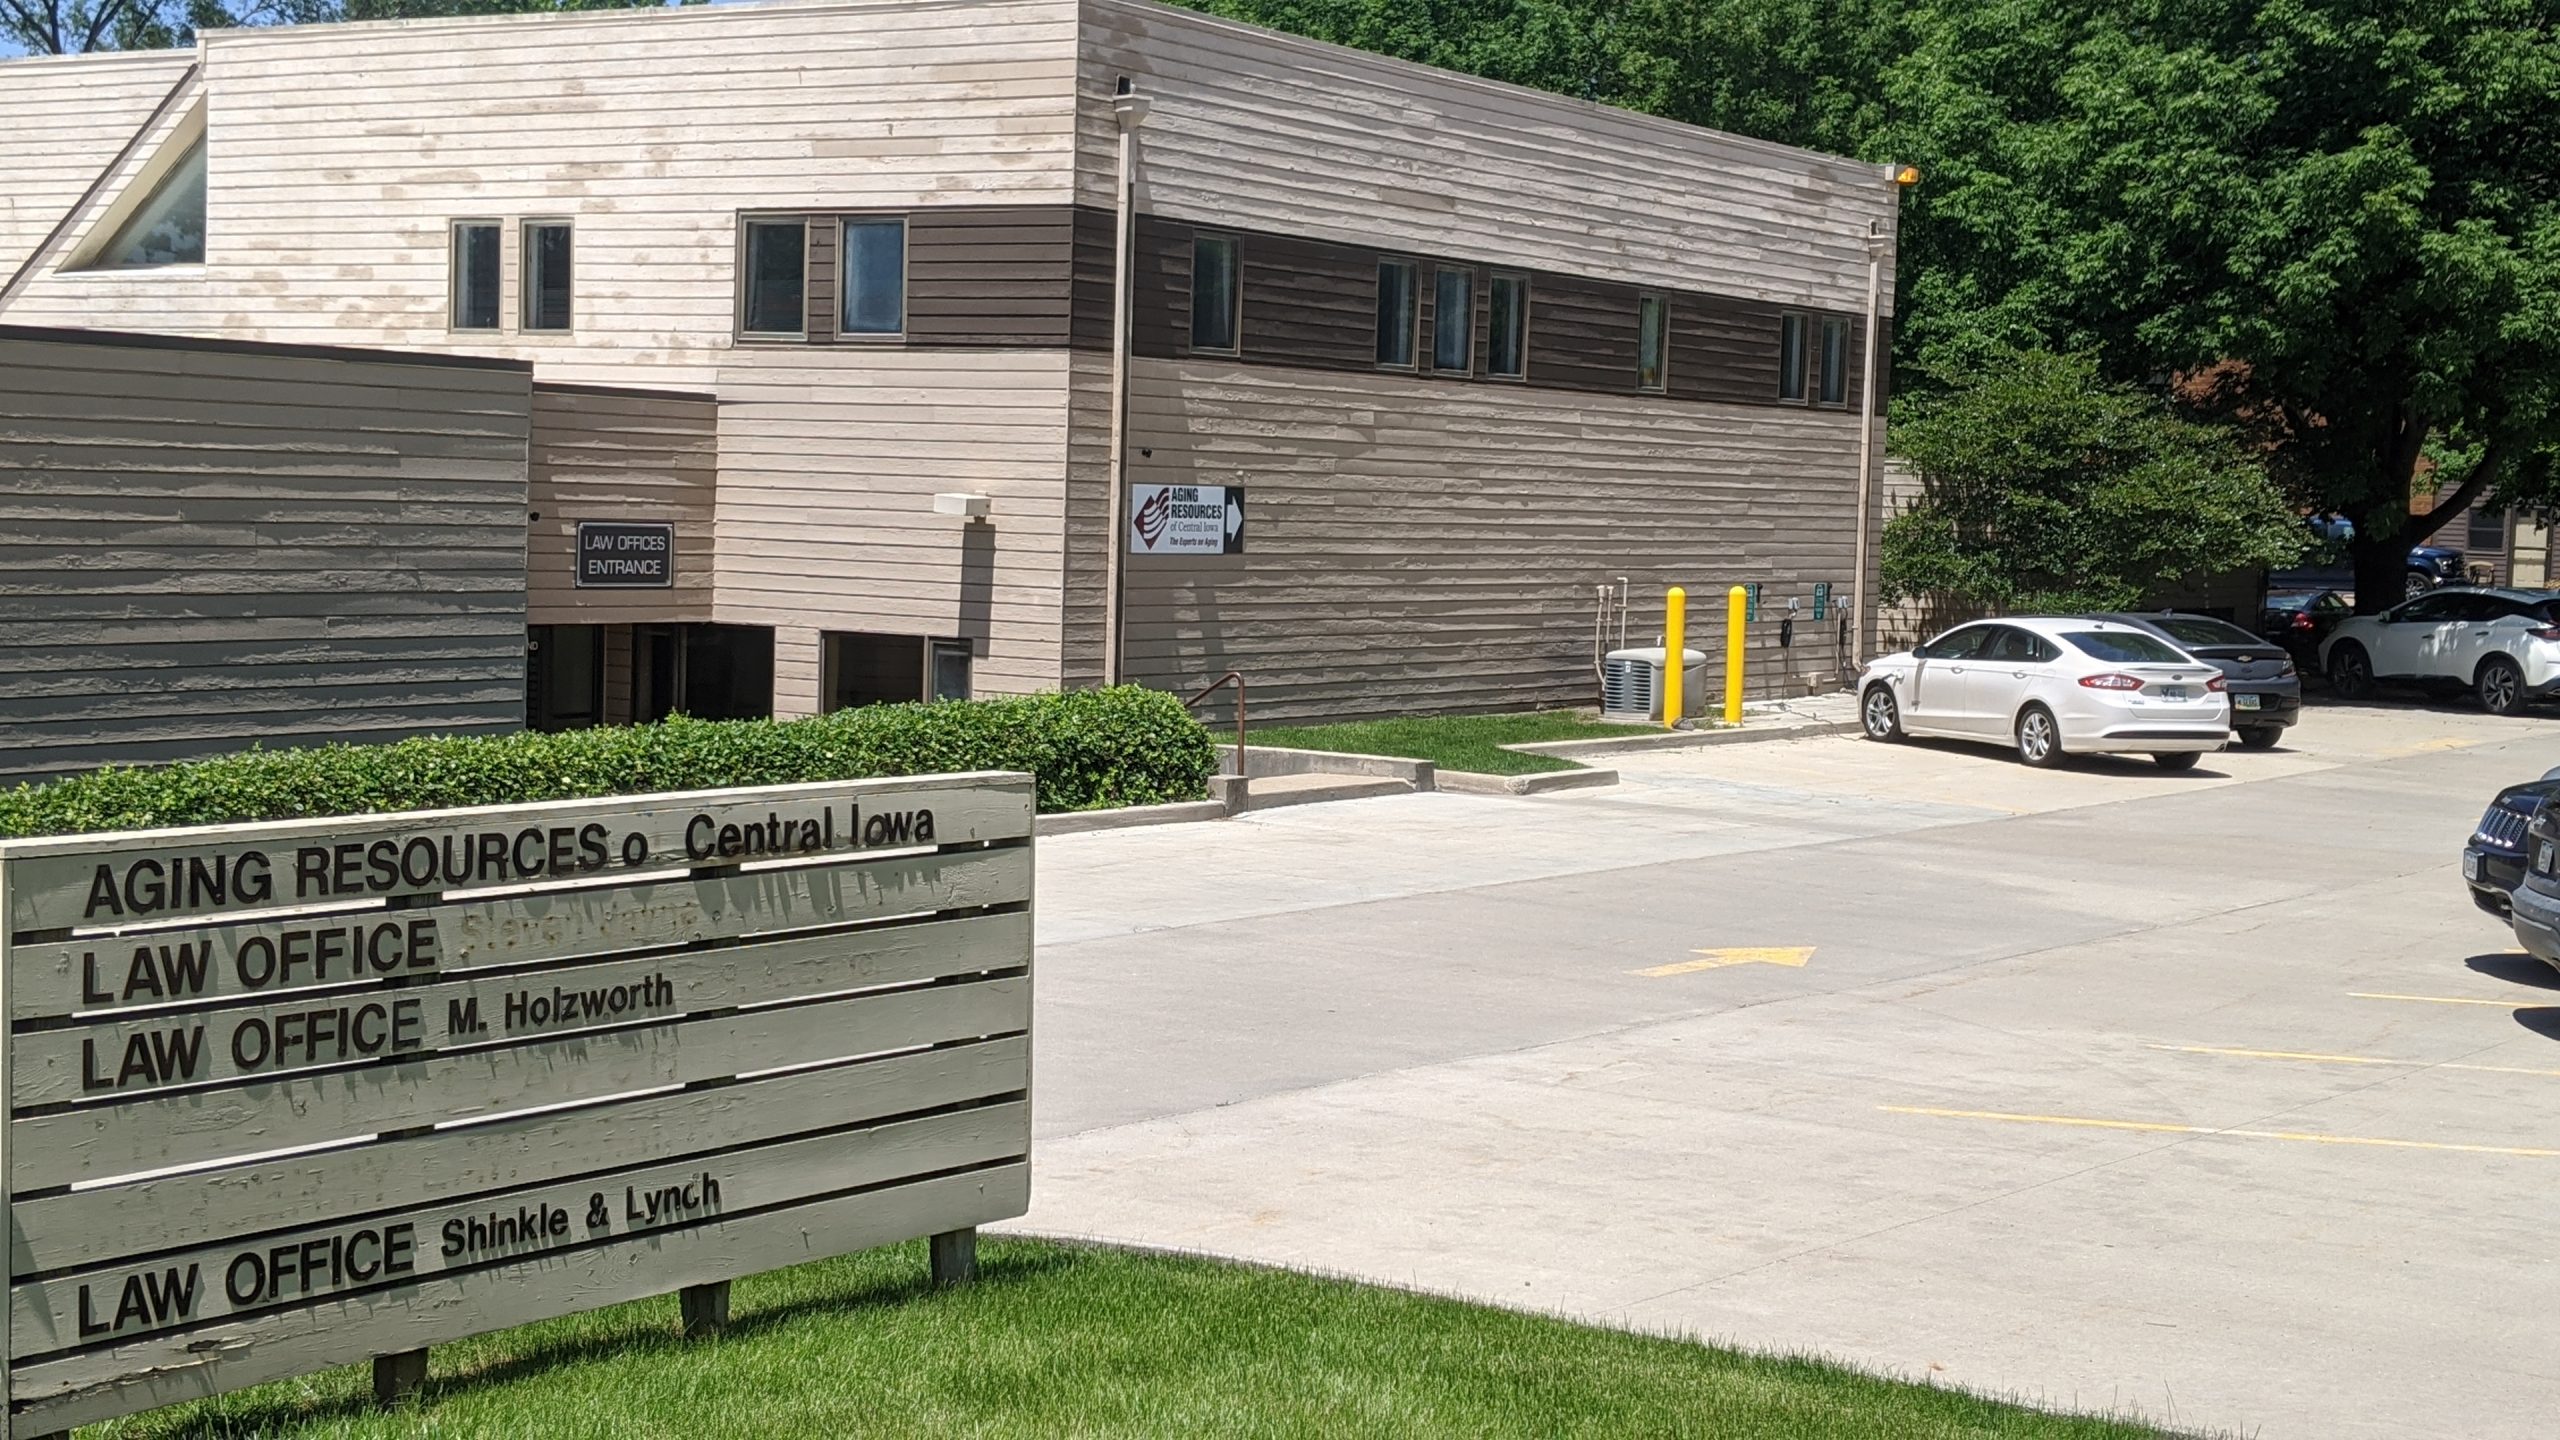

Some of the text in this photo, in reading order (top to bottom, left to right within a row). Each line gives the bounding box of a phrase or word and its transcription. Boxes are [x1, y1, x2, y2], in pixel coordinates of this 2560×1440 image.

[1171, 487, 1198, 502] AGING
[1171, 504, 1222, 519] RESOURCES
[1170, 521, 1218, 532] of Central Iowa
[585, 535, 666, 550] LAW OFFICES
[588, 560, 662, 575] ENTRANCE
[85, 851, 272, 918] AGING
[297, 823, 610, 899] RESOURCES
[685, 806, 833, 860] Central
[852, 803, 935, 847] Iowa
[82, 939, 212, 1005] LAW
[237, 918, 437, 988] OFFICE
[82, 972, 674, 1090] LAW OFFICE M. Holzworth
[79, 1172, 720, 1338] LAW OFFICE Shinkle & Lynch
